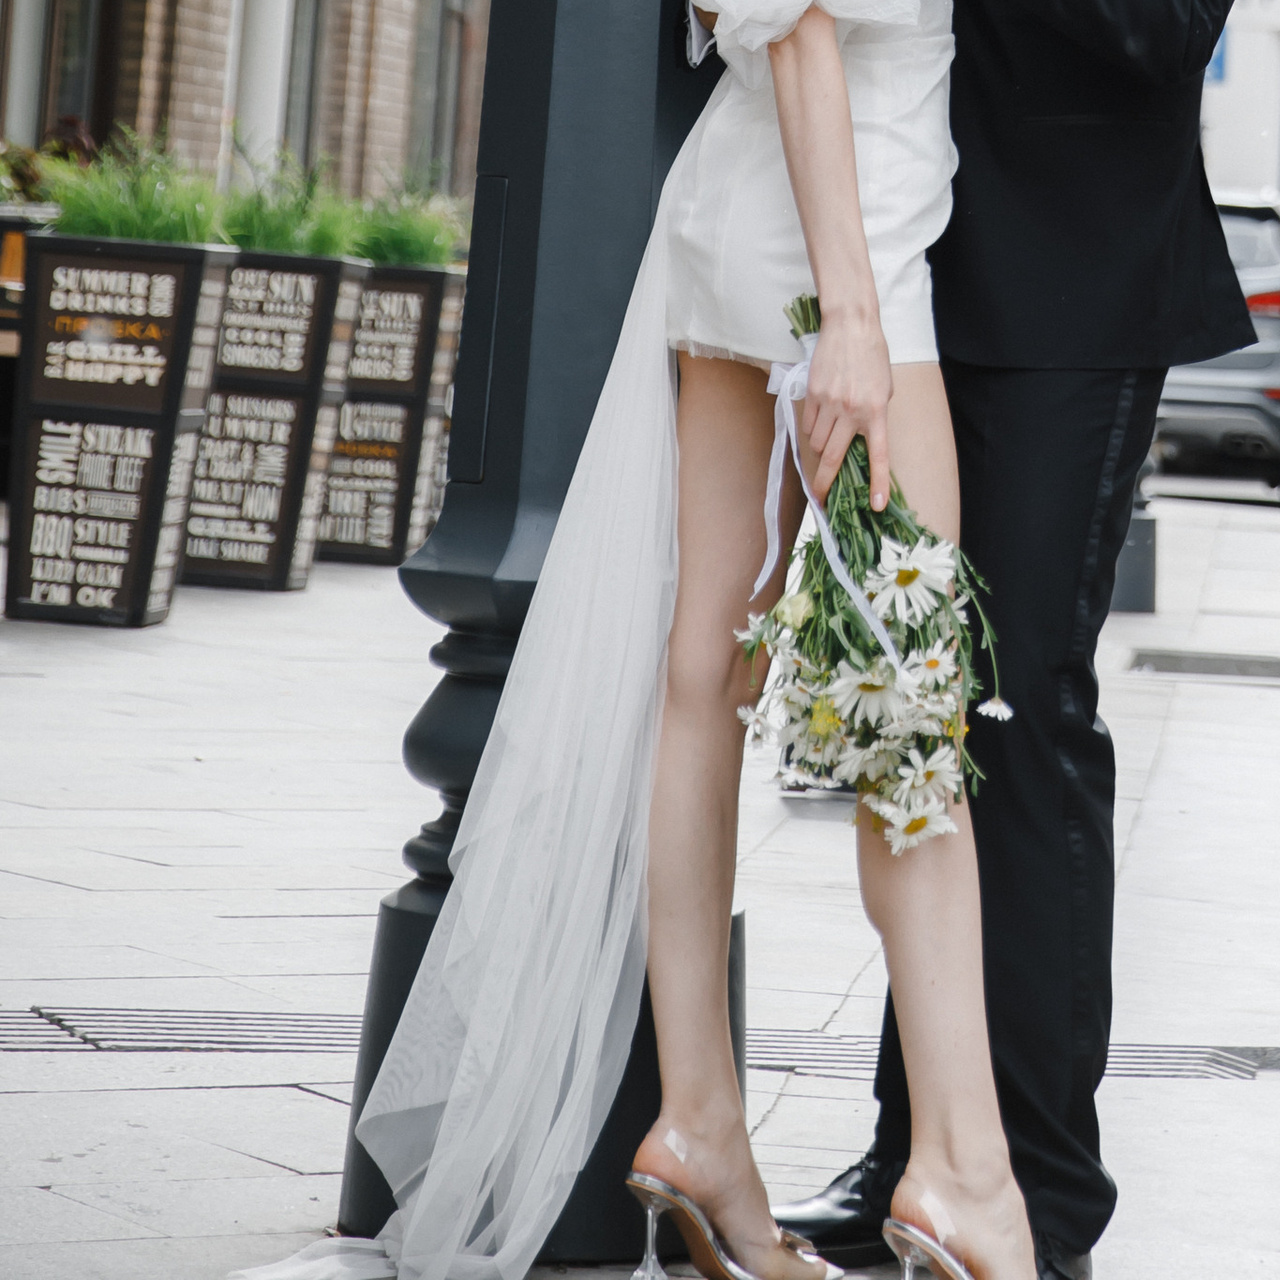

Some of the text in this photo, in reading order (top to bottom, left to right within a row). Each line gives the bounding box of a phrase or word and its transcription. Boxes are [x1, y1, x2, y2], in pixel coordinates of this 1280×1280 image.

[53, 266, 150, 297] SUMMER
[50, 290, 149, 316] DRINKS
[74, 518, 133, 548] STYLE
[76, 585, 117, 609] OK
